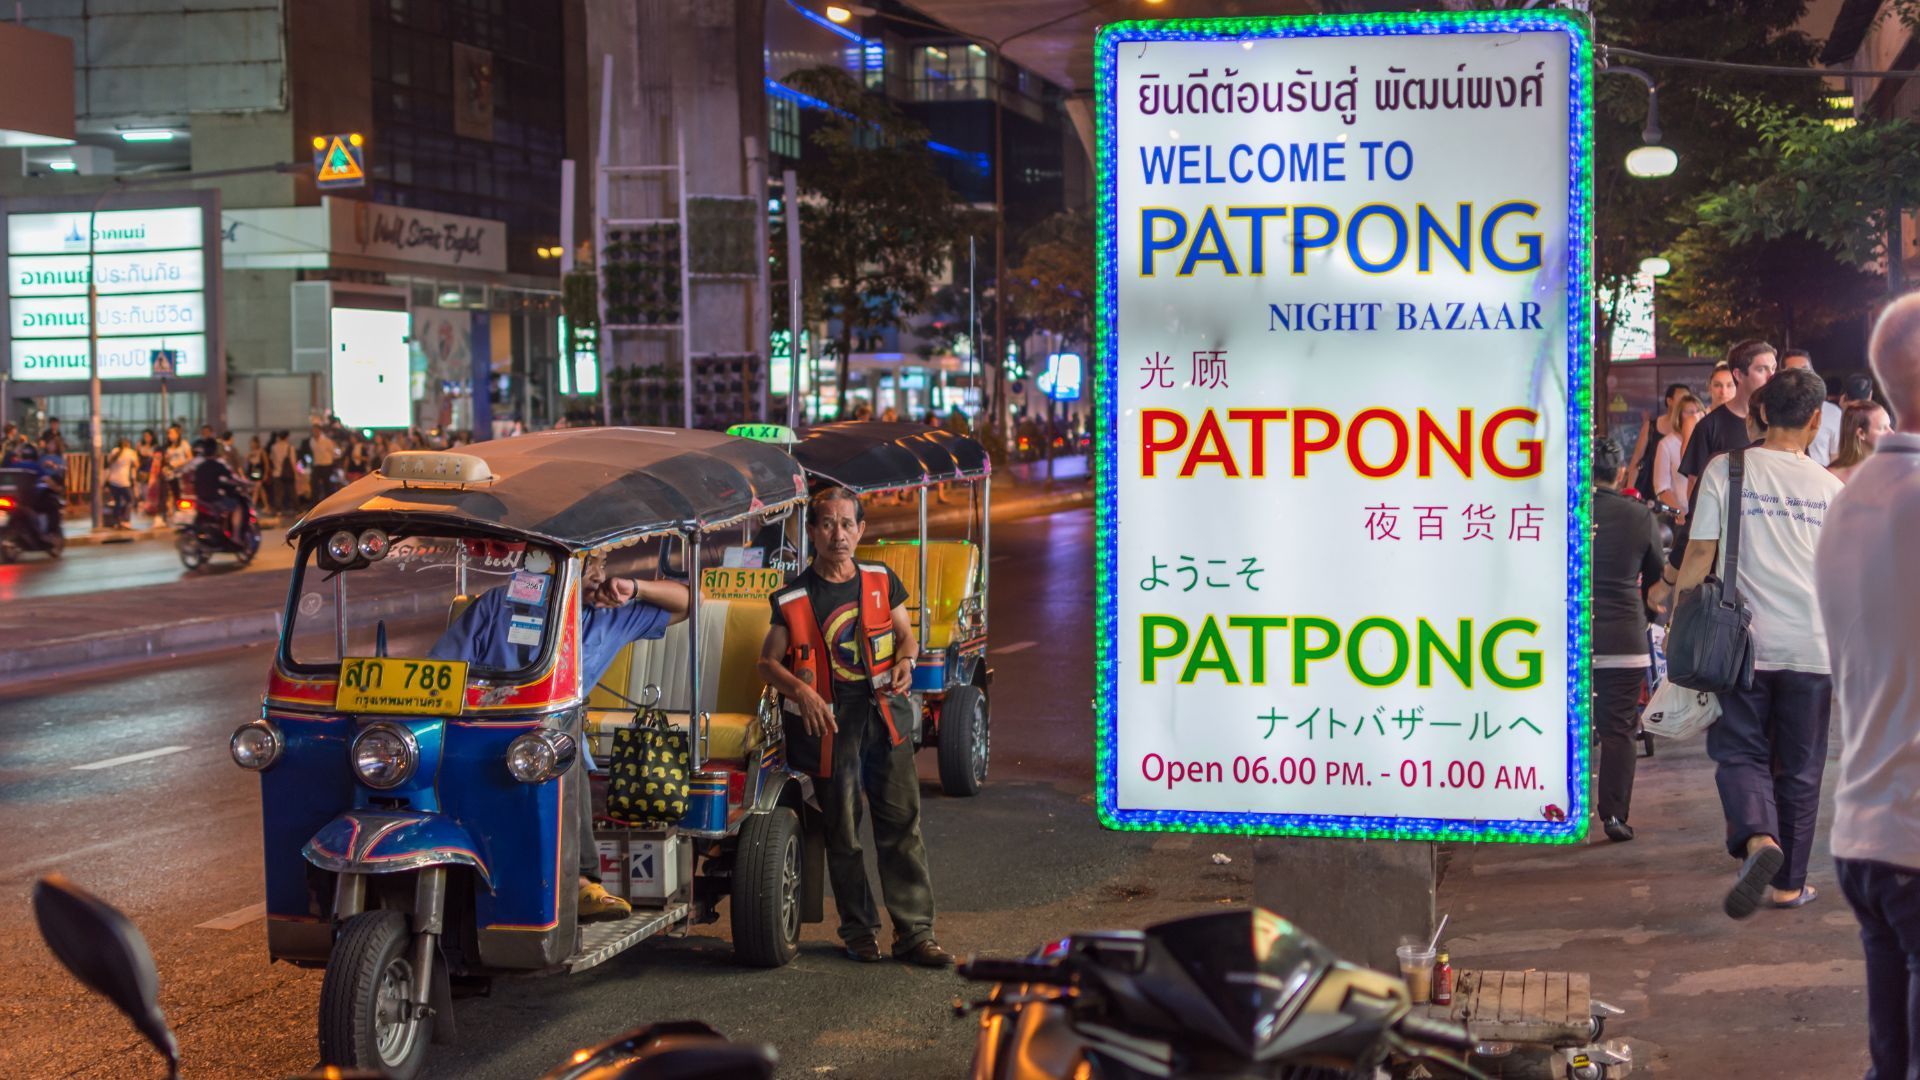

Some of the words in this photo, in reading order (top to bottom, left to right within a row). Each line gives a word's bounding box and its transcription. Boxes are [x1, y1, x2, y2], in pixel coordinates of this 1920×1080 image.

[1139, 66, 1358, 125] ยินดีต้อนรับสู่
[1376, 61, 1545, 110] พัฒน์พงศ์
[1140, 143, 1346, 185] WELCOME
[1360, 140, 1414, 181] TO
[1139, 201, 1544, 277] PATPONG
[1269, 302, 1382, 332] NIGHT
[1396, 301, 1544, 332] BAZAAR
[1140, 350, 1229, 390] 光顾
[737, 426, 779, 438] TAXI
[1140, 407, 1545, 480] PATPONG
[1364, 503, 1546, 542] 夜百货店
[736, 571, 778, 588] 5110
[1140, 555, 1265, 592] ようこそ
[872, 591, 881, 609] 7
[1140, 613, 1545, 691] PATPONG
[403, 664, 452, 690] 786
[1257, 706, 1543, 741] ナイトバザールへ
[1141, 753, 1224, 789] Open
[1232, 756, 1316, 786] 06.00
[1326, 762, 1373, 786] PM.
[1400, 760, 1485, 789] 01.00
[1494, 765, 1545, 791] AM.
